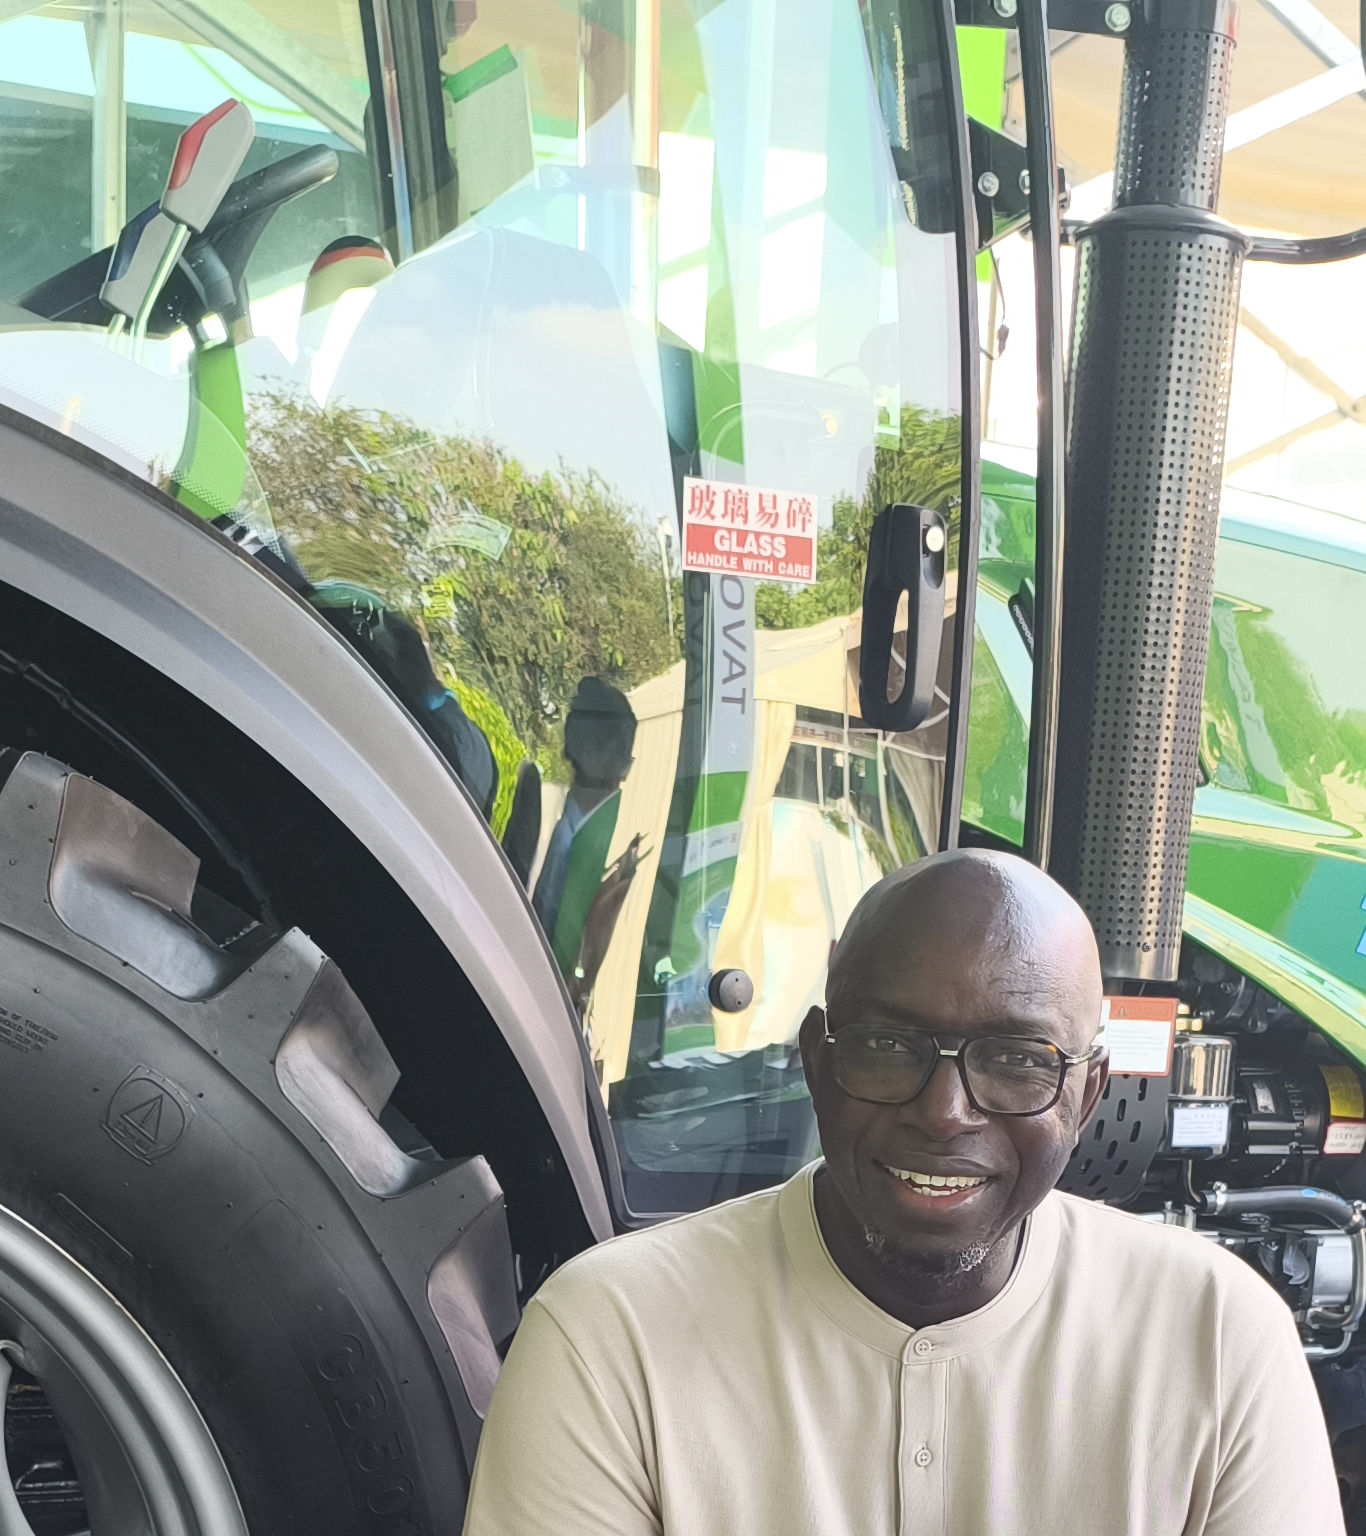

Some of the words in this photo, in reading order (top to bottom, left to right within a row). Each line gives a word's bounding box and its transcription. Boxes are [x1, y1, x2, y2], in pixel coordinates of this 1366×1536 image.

[688, 484, 813, 533] 玻璃易碎
[714, 529, 787, 559] GLASS
[687, 551, 738, 569] HANDLE
[742, 557, 774, 574] WITH
[778, 562, 811, 578] CARE
